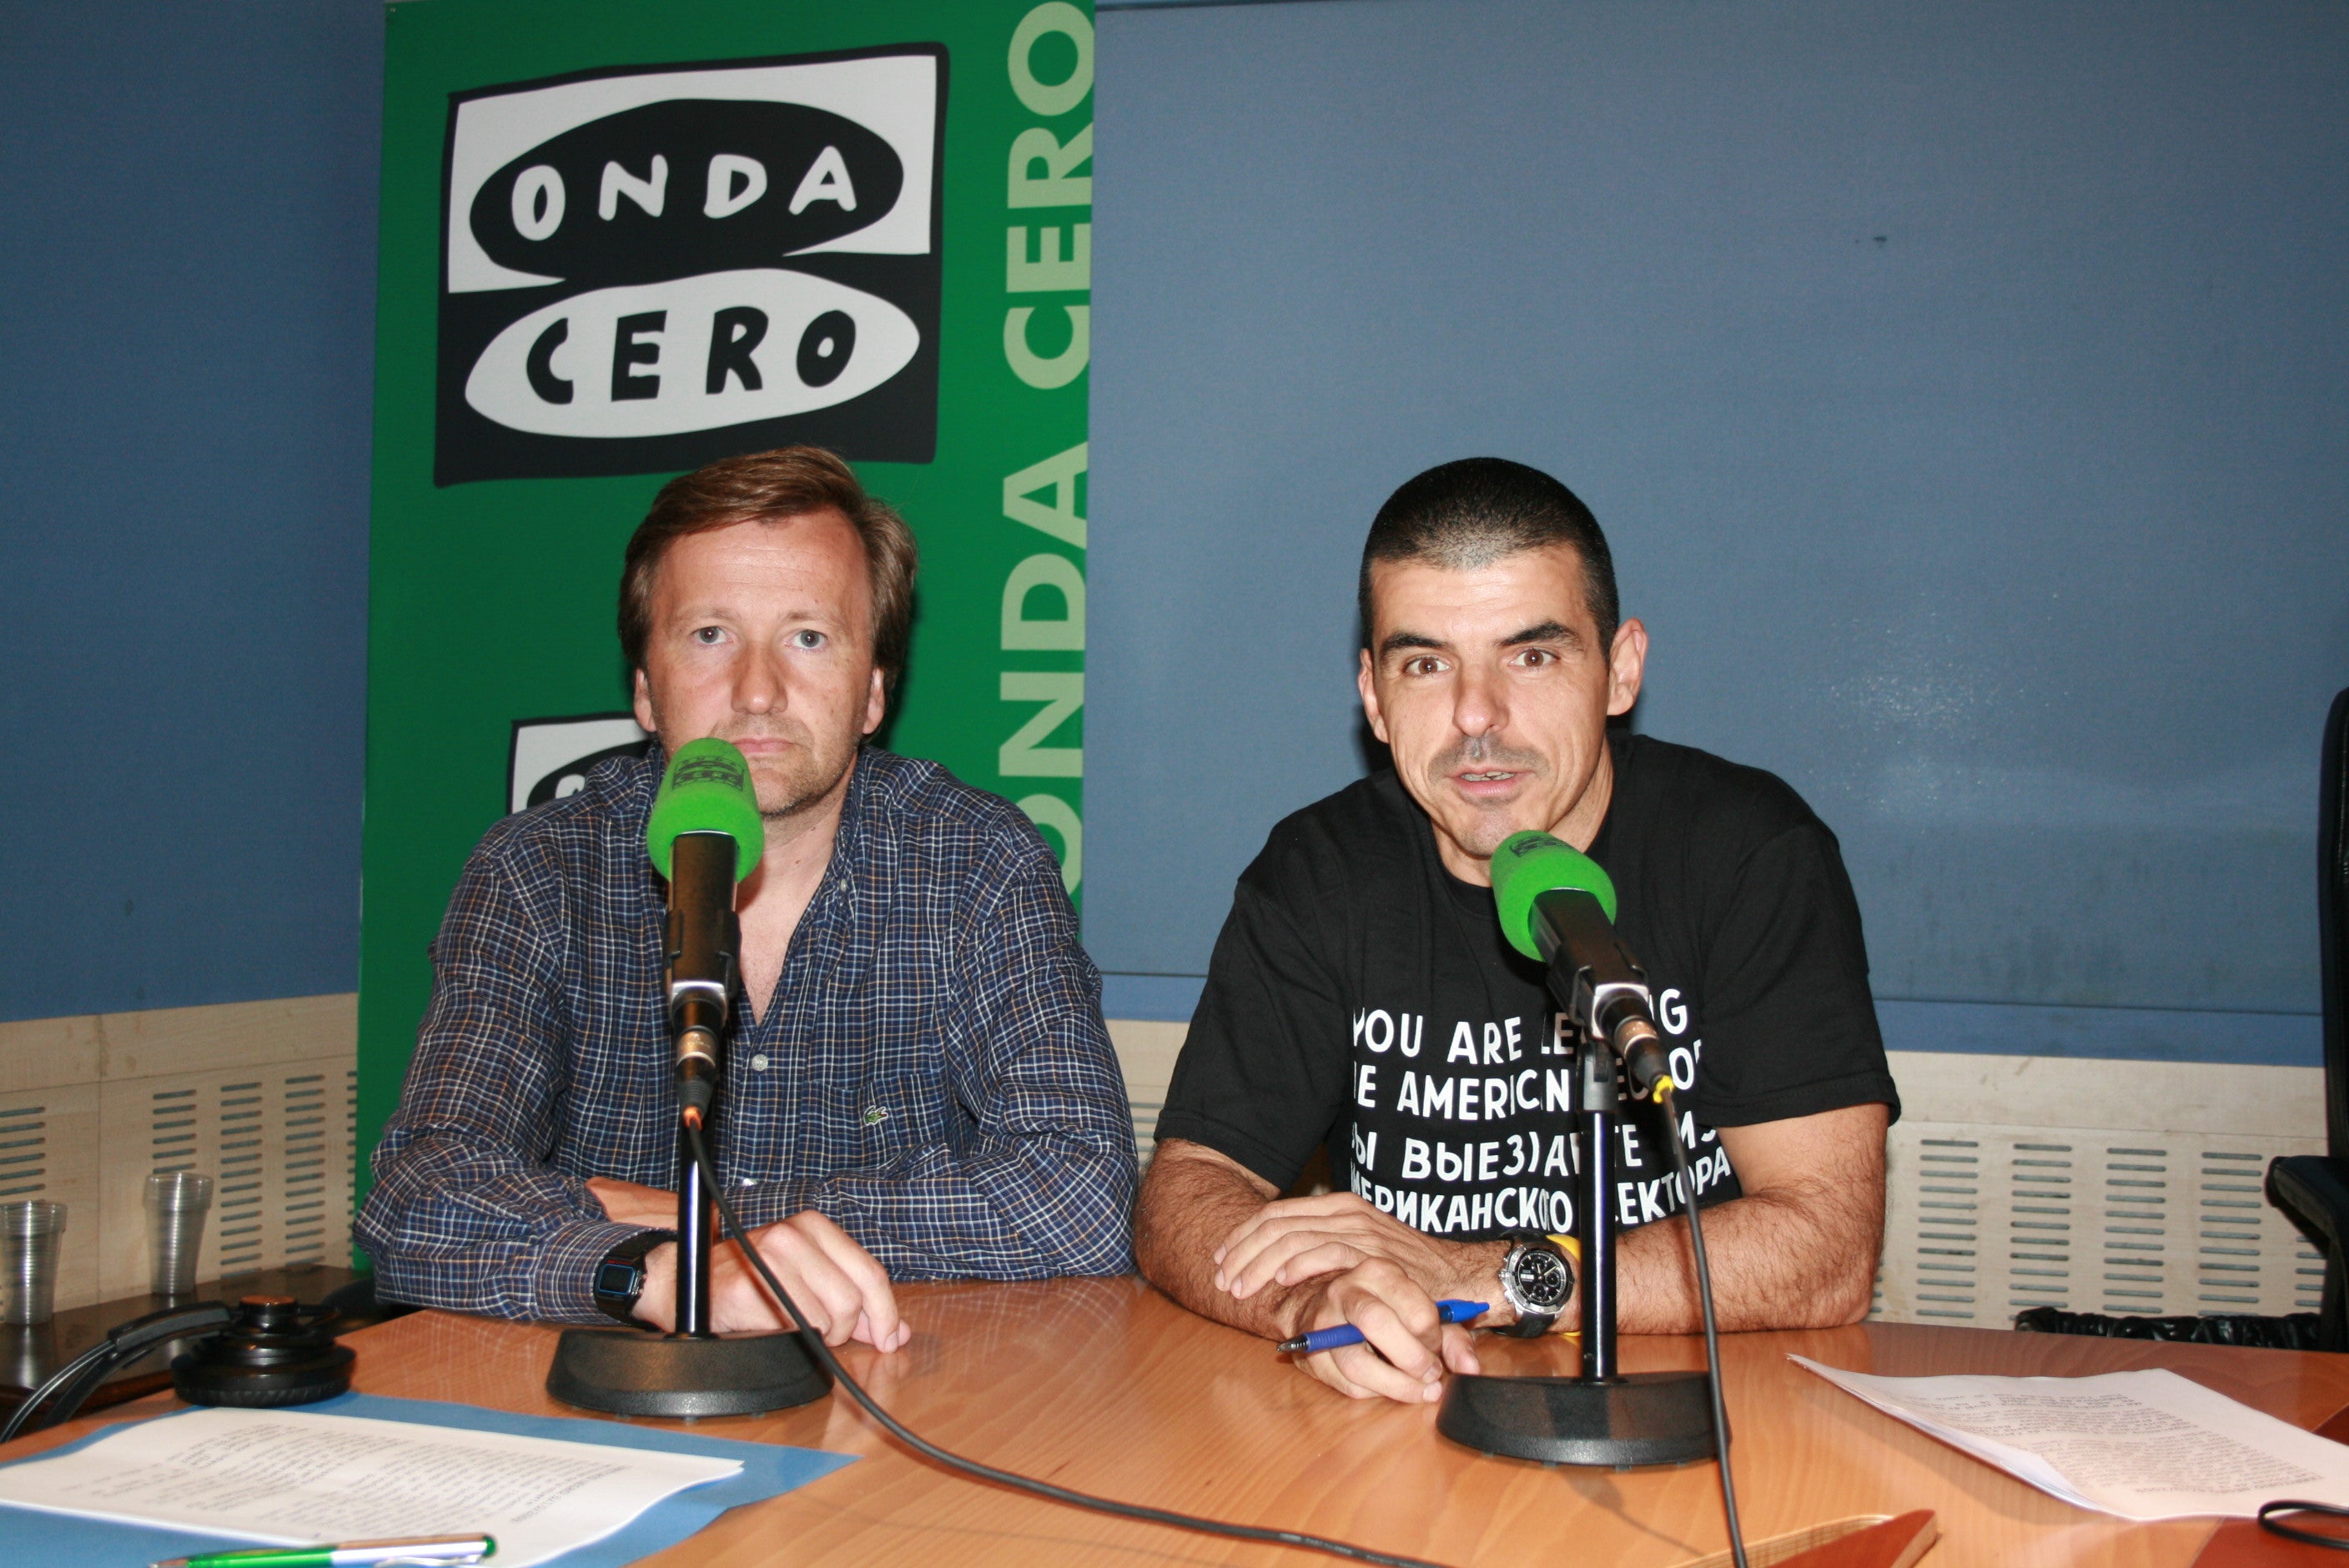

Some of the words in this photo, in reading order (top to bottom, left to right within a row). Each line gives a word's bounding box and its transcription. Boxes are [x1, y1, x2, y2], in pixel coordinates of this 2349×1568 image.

[511, 145, 857, 241] ONDA
[1003, 1, 1094, 389] CERO
[526, 305, 857, 405] CERO
[1353, 1007, 1423, 1058] YOU
[1446, 1017, 1522, 1065] ARE
[1396, 1069, 1570, 1120] AMERICN
[1615, 1145, 1732, 1225] ЕКТОРА
